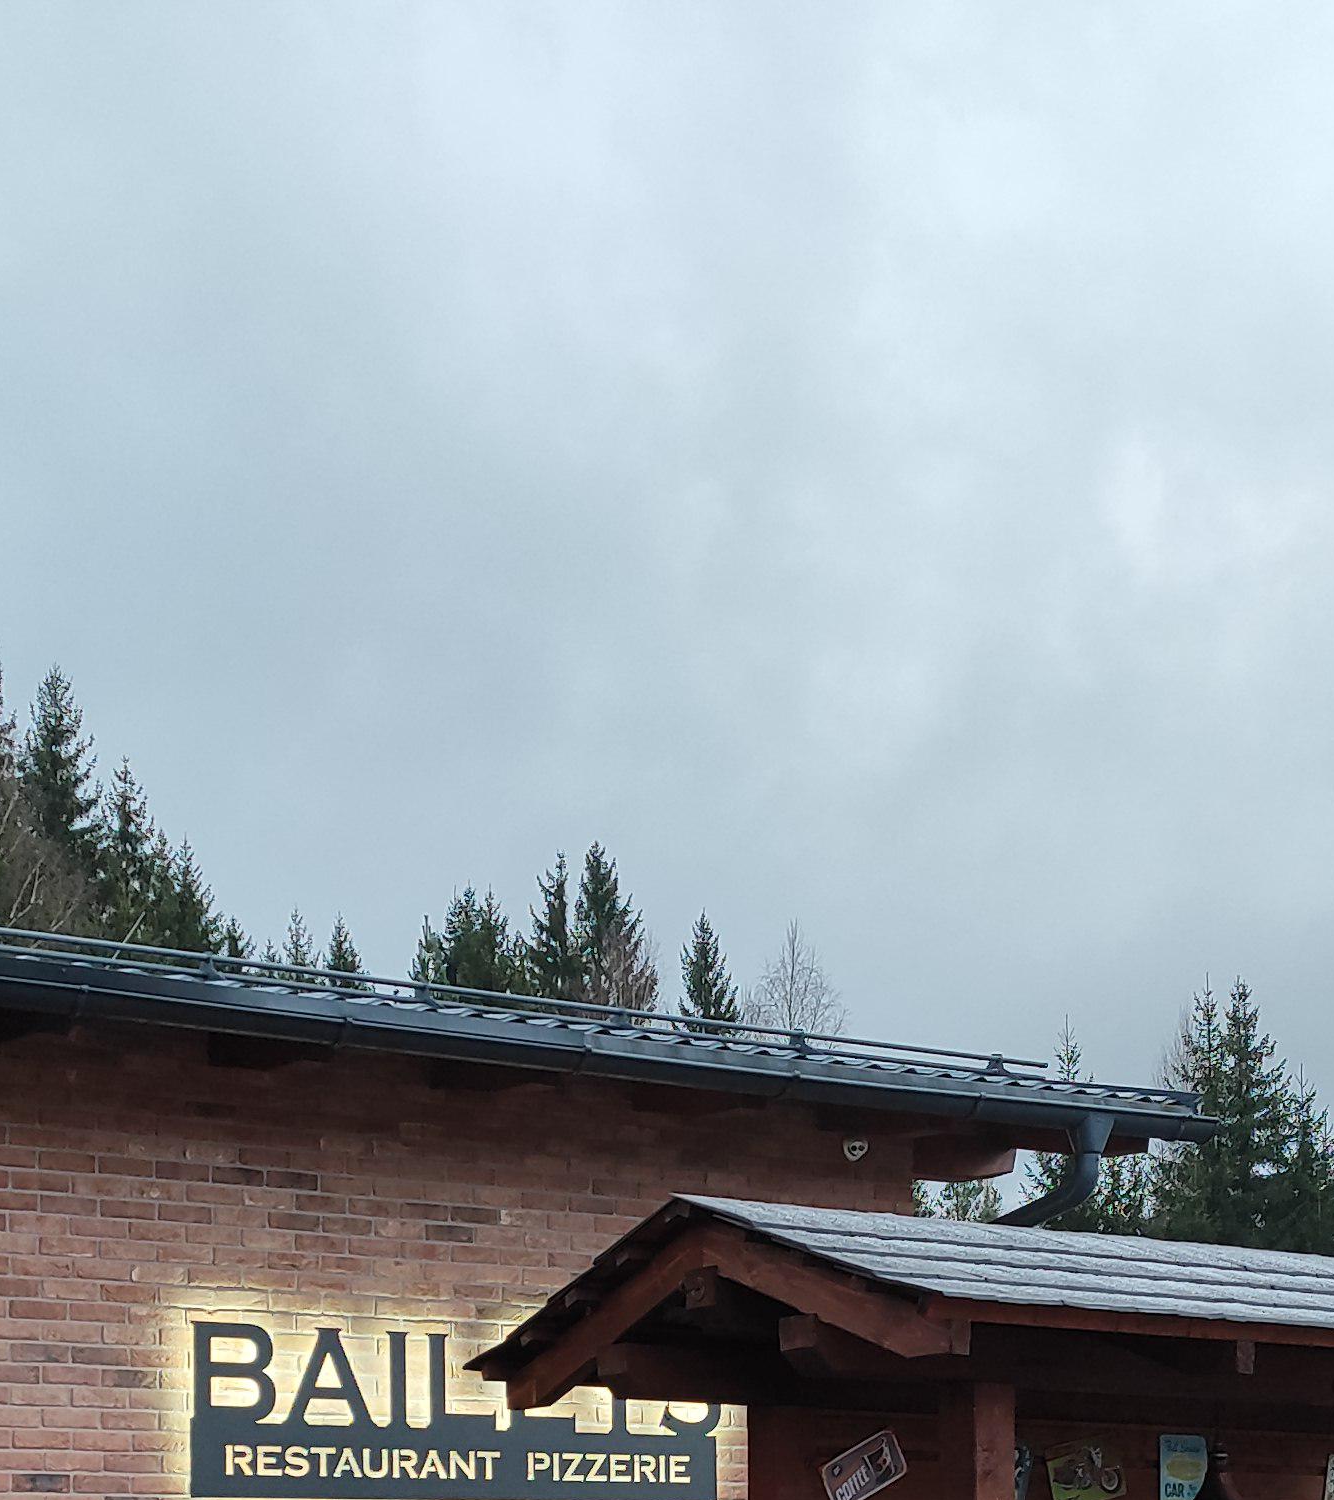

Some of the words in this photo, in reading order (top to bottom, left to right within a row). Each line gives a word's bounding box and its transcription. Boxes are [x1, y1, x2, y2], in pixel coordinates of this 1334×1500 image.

[191, 1321, 720, 1436] BAIL
[224, 1444, 501, 1481] RESTAURANT
[526, 1451, 691, 1484] PIZZERIE
[1165, 1483, 1185, 1498] CAR
